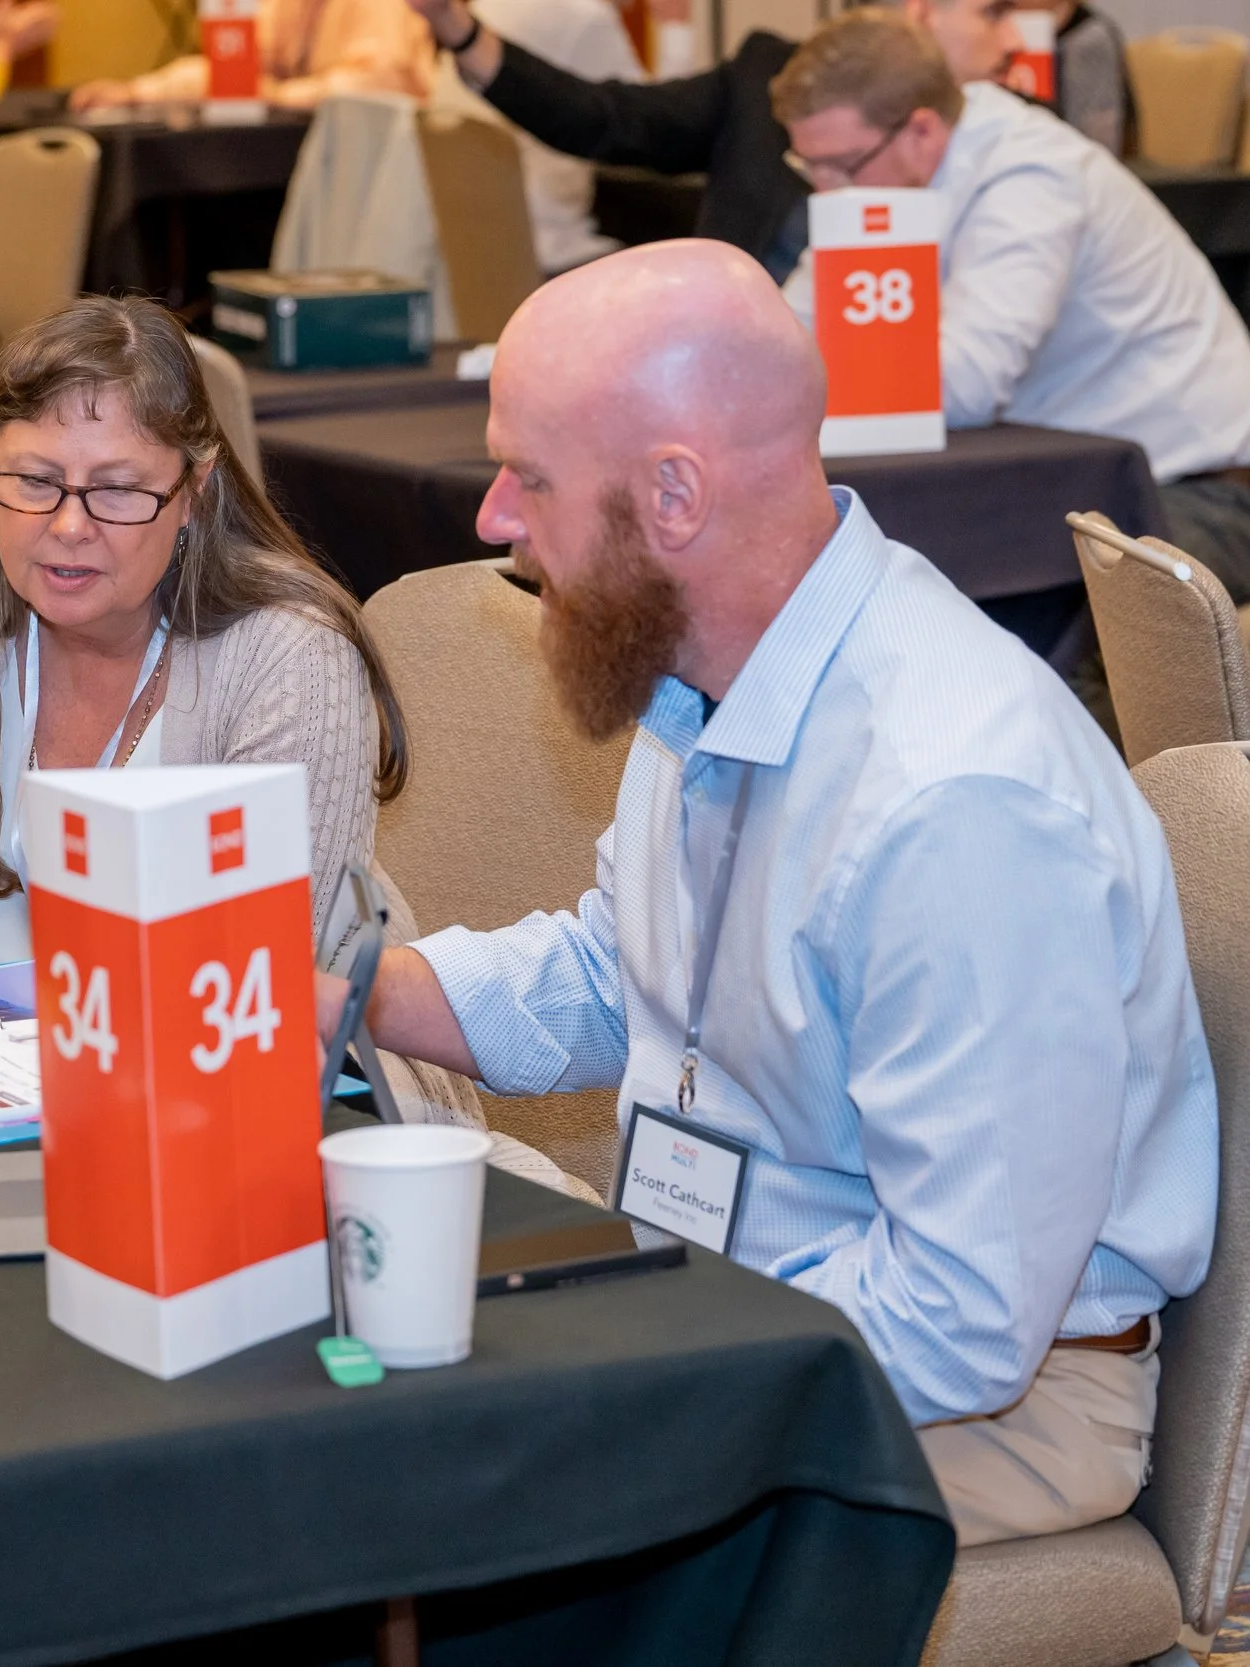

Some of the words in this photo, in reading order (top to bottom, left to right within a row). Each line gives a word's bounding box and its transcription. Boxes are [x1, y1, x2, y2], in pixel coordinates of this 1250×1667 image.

[842, 268, 914, 325] 38
[50, 949, 119, 1074] 34
[189, 946, 282, 1074] 34
[631, 1167, 666, 1195] Scott
[669, 1183, 726, 1220] Cathcart
